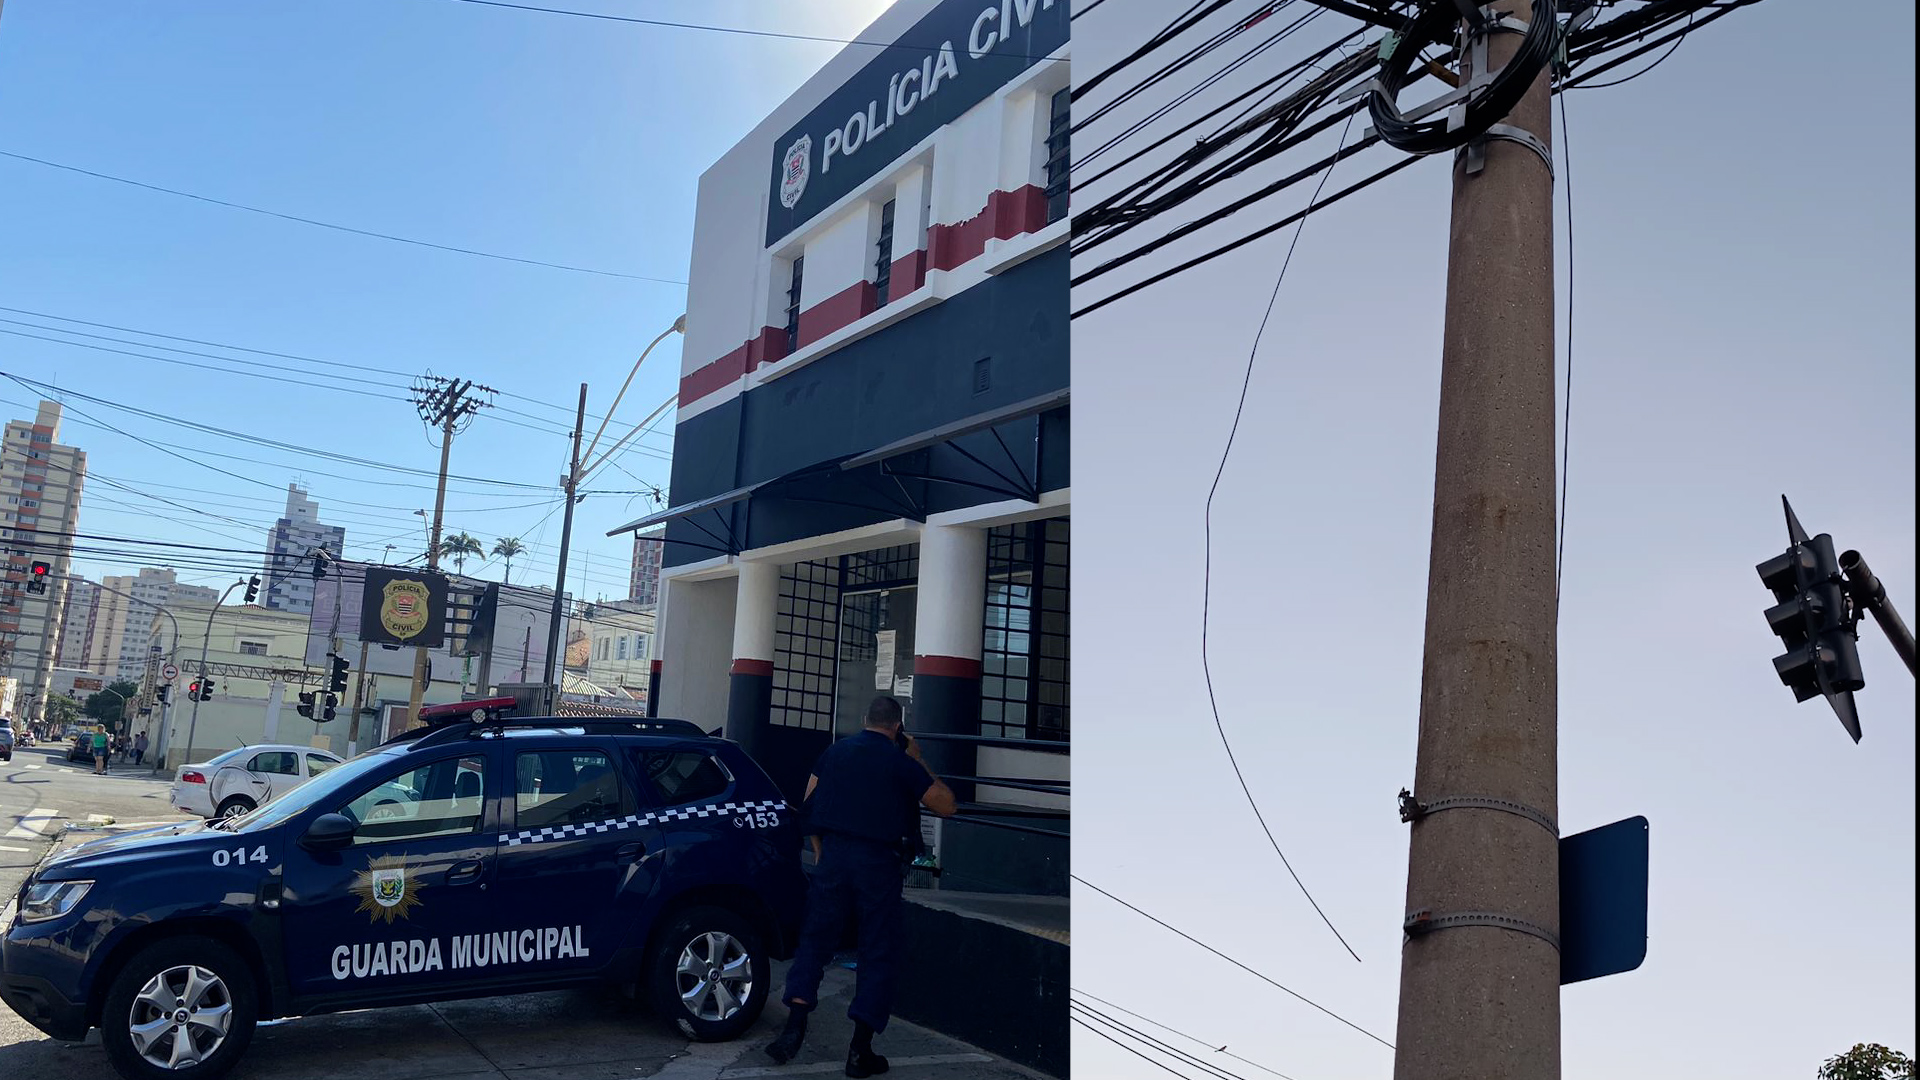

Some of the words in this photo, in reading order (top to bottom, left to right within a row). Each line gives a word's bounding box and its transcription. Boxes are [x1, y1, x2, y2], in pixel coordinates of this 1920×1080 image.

[822, 40, 959, 174] POLÍCIA
[968, 0, 1054, 59] CIV
[393, 623, 415, 631] CIVIL
[744, 811, 779, 829] 153
[212, 845, 268, 867] 014
[331, 937, 444, 980] GUARDA
[451, 925, 590, 970] MUNICIPAL
